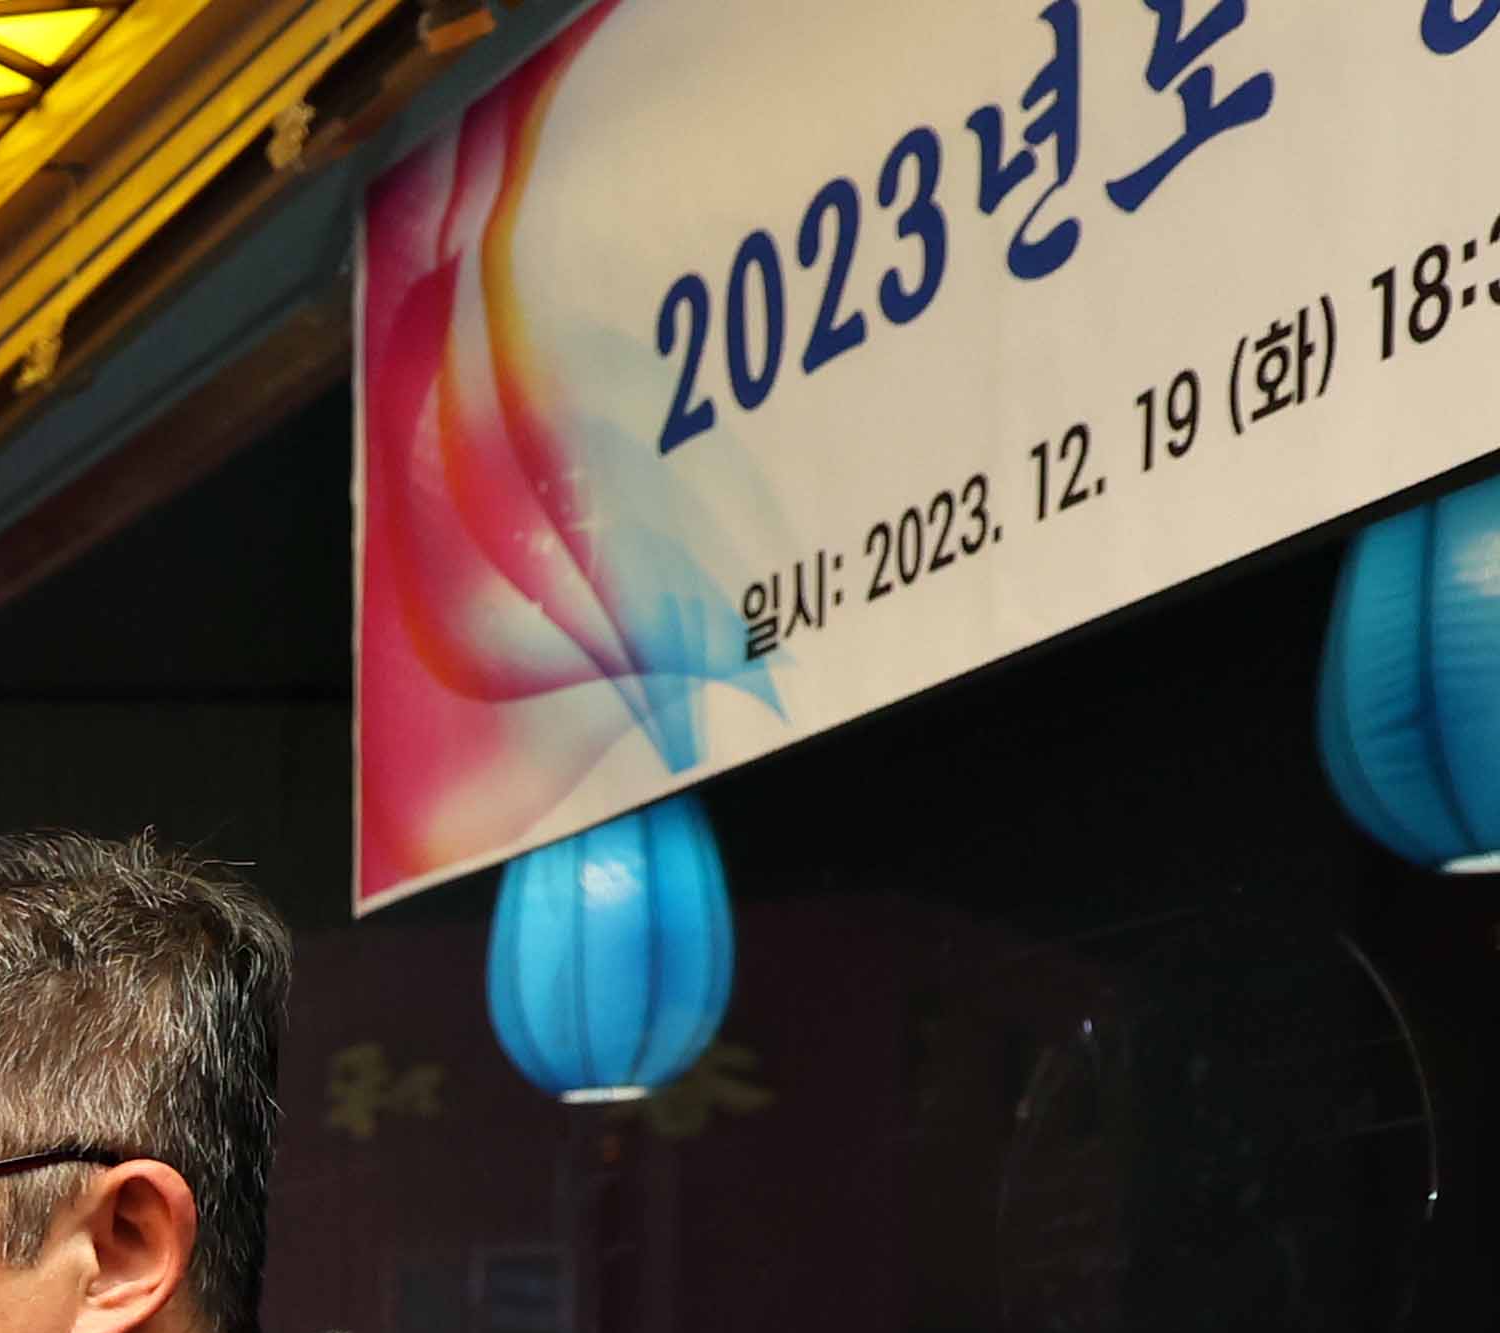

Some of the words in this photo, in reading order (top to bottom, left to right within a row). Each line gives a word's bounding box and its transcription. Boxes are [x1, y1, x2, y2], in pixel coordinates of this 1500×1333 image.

[656, 0, 1275, 457] 2023년도
[742, 549, 844, 662] 일시:
[864, 472, 1003, 602] 2023.
[1029, 422, 1107, 523] 12.
[1134, 367, 1201, 473] 19
[1229, 294, 1338, 436] (화)
[1371, 212, 1500, 361] 18:
